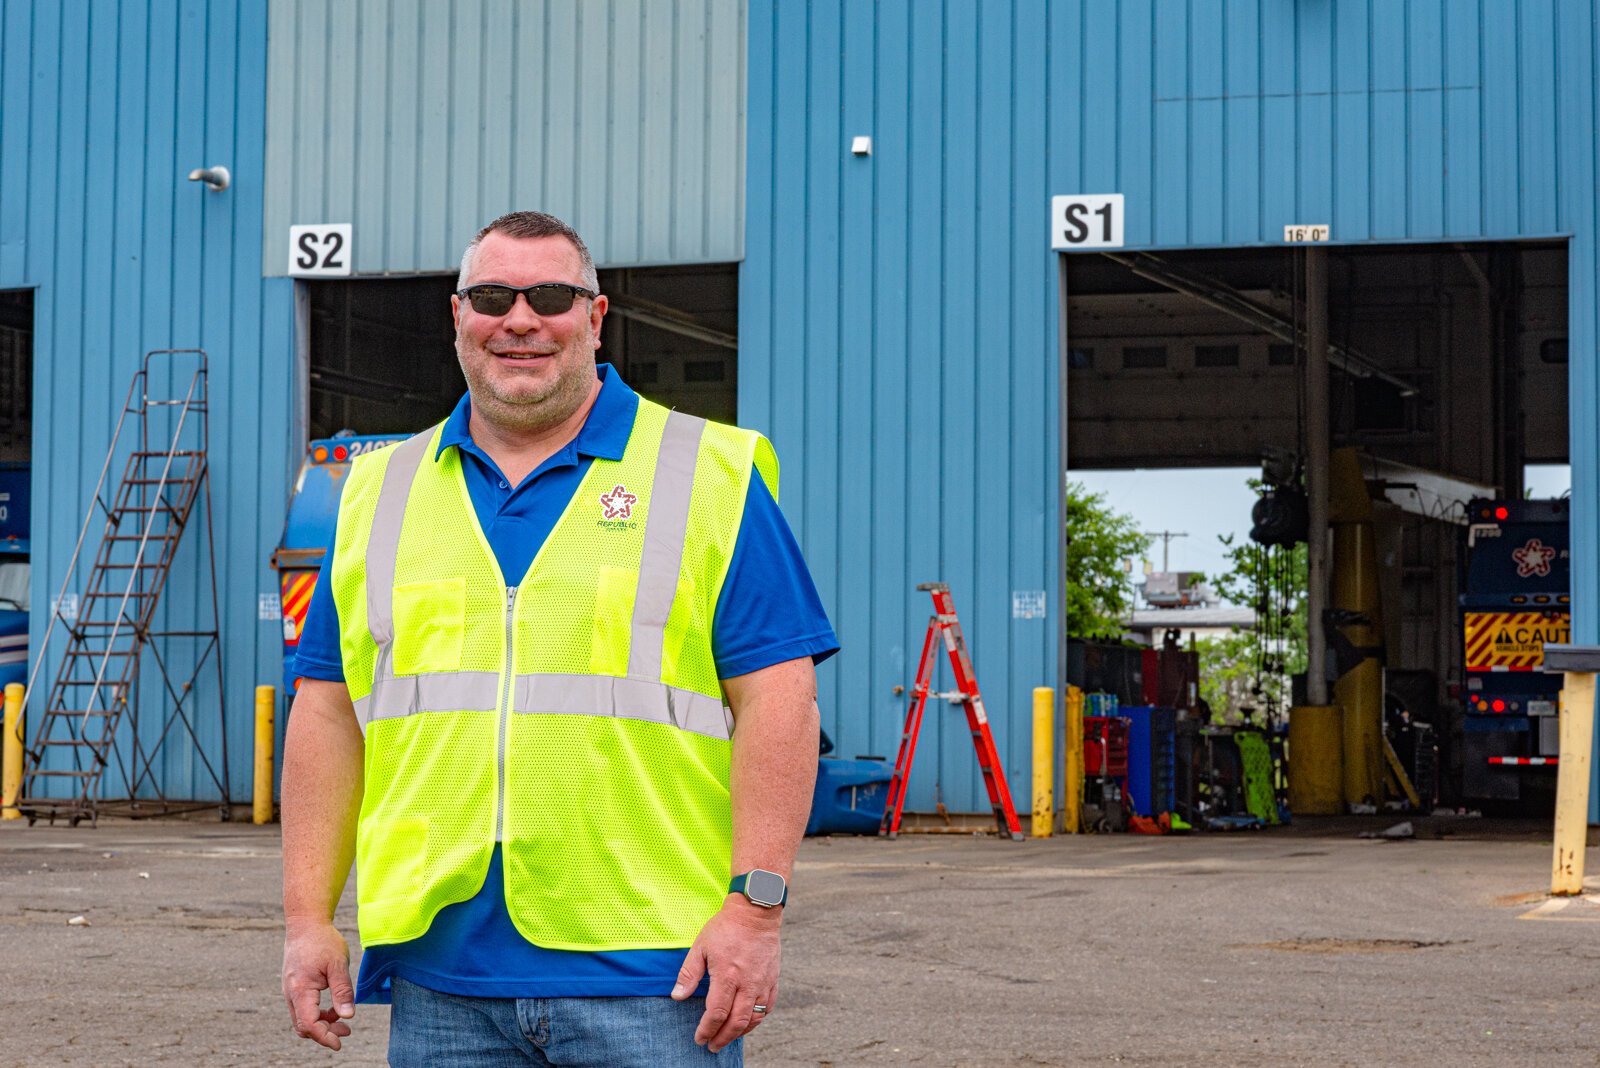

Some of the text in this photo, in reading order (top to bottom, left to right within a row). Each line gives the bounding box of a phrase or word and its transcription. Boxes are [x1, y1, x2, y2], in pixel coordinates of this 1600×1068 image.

[1064, 203, 1112, 243] S1
[297, 232, 343, 269] S2
[597, 520, 637, 529] REPUBLIC
[1515, 628, 1570, 644] CAUT
